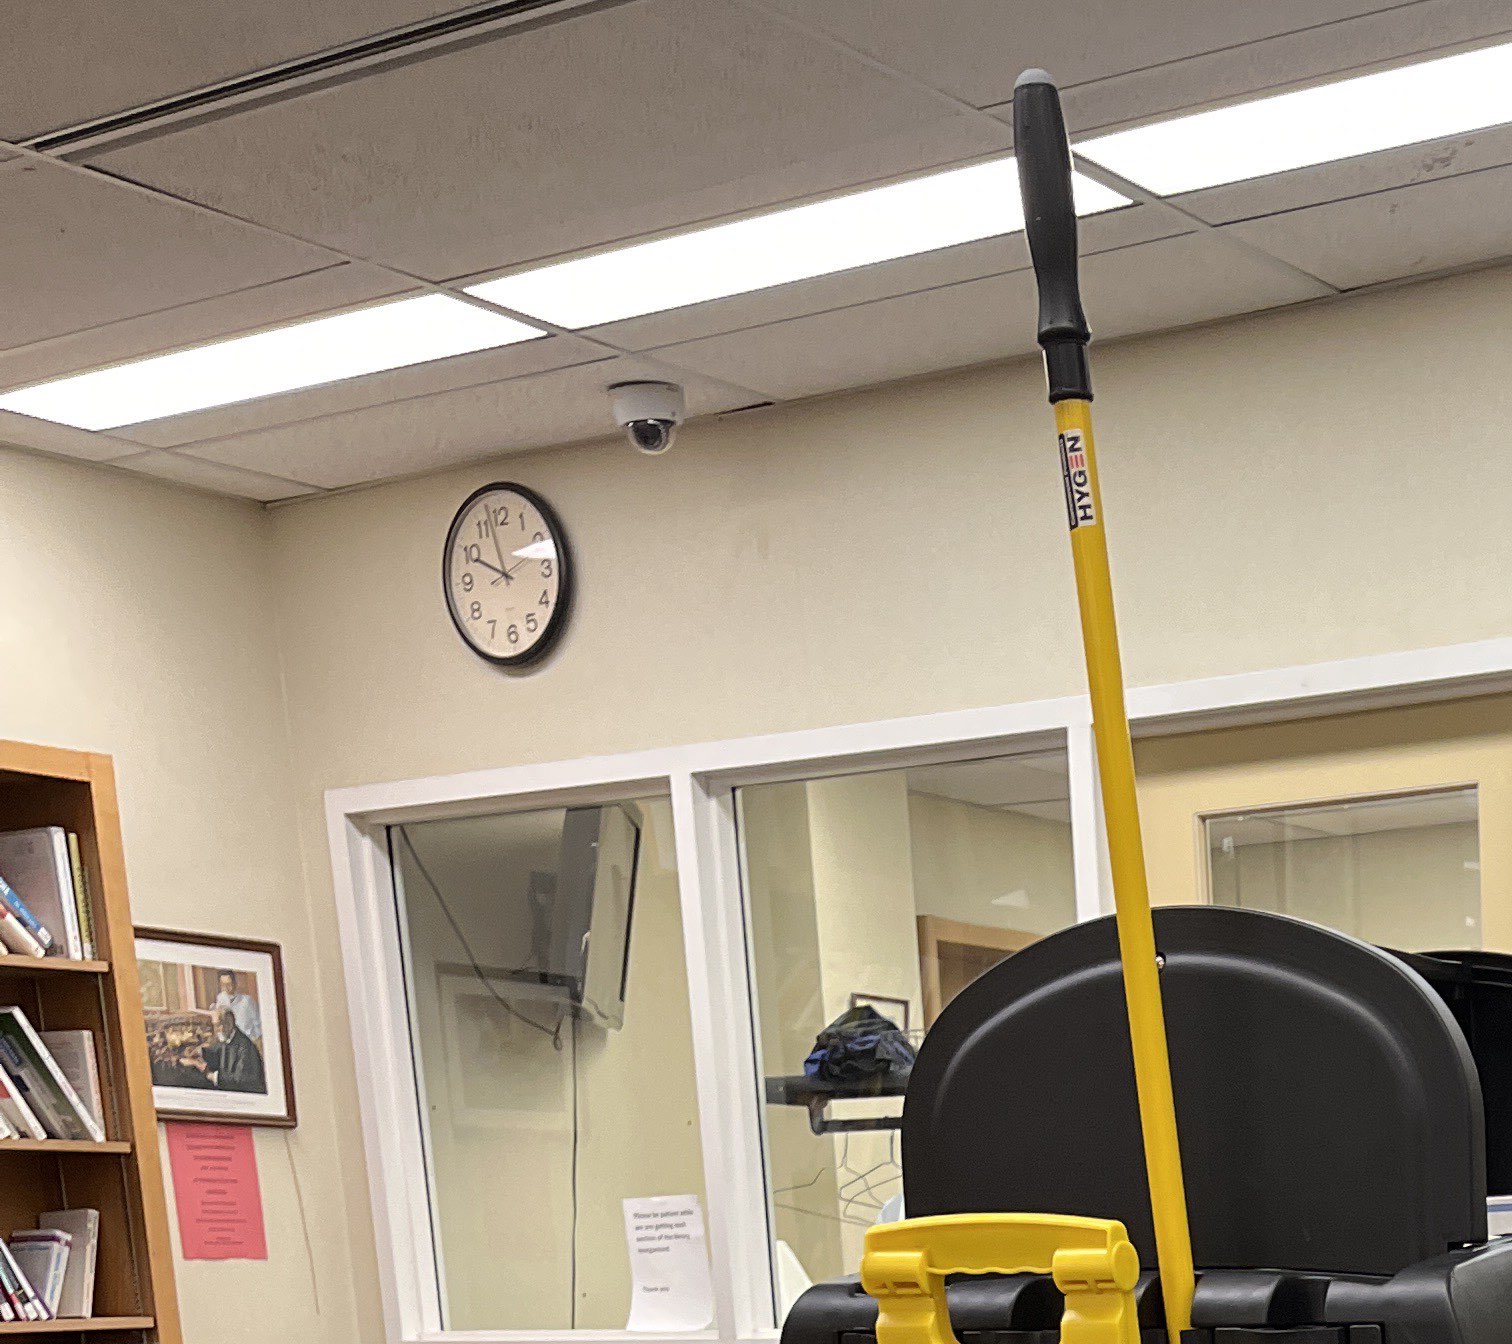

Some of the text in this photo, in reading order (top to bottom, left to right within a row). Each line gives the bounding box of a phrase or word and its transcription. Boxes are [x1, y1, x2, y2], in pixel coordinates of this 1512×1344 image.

[1066, 434, 1094, 522] HYGEN
[492, 506, 509, 527] 12
[519, 513, 526, 531] 1
[477, 519, 489, 538] 11
[463, 543, 481, 564] 10
[541, 559, 552, 578] 3
[461, 573, 473, 592] 9
[538, 589, 550, 608] 4
[470, 601, 482, 620] 8
[487, 620, 497, 639] 7
[526, 613, 538, 633] 5
[506, 624, 518, 644] 6
